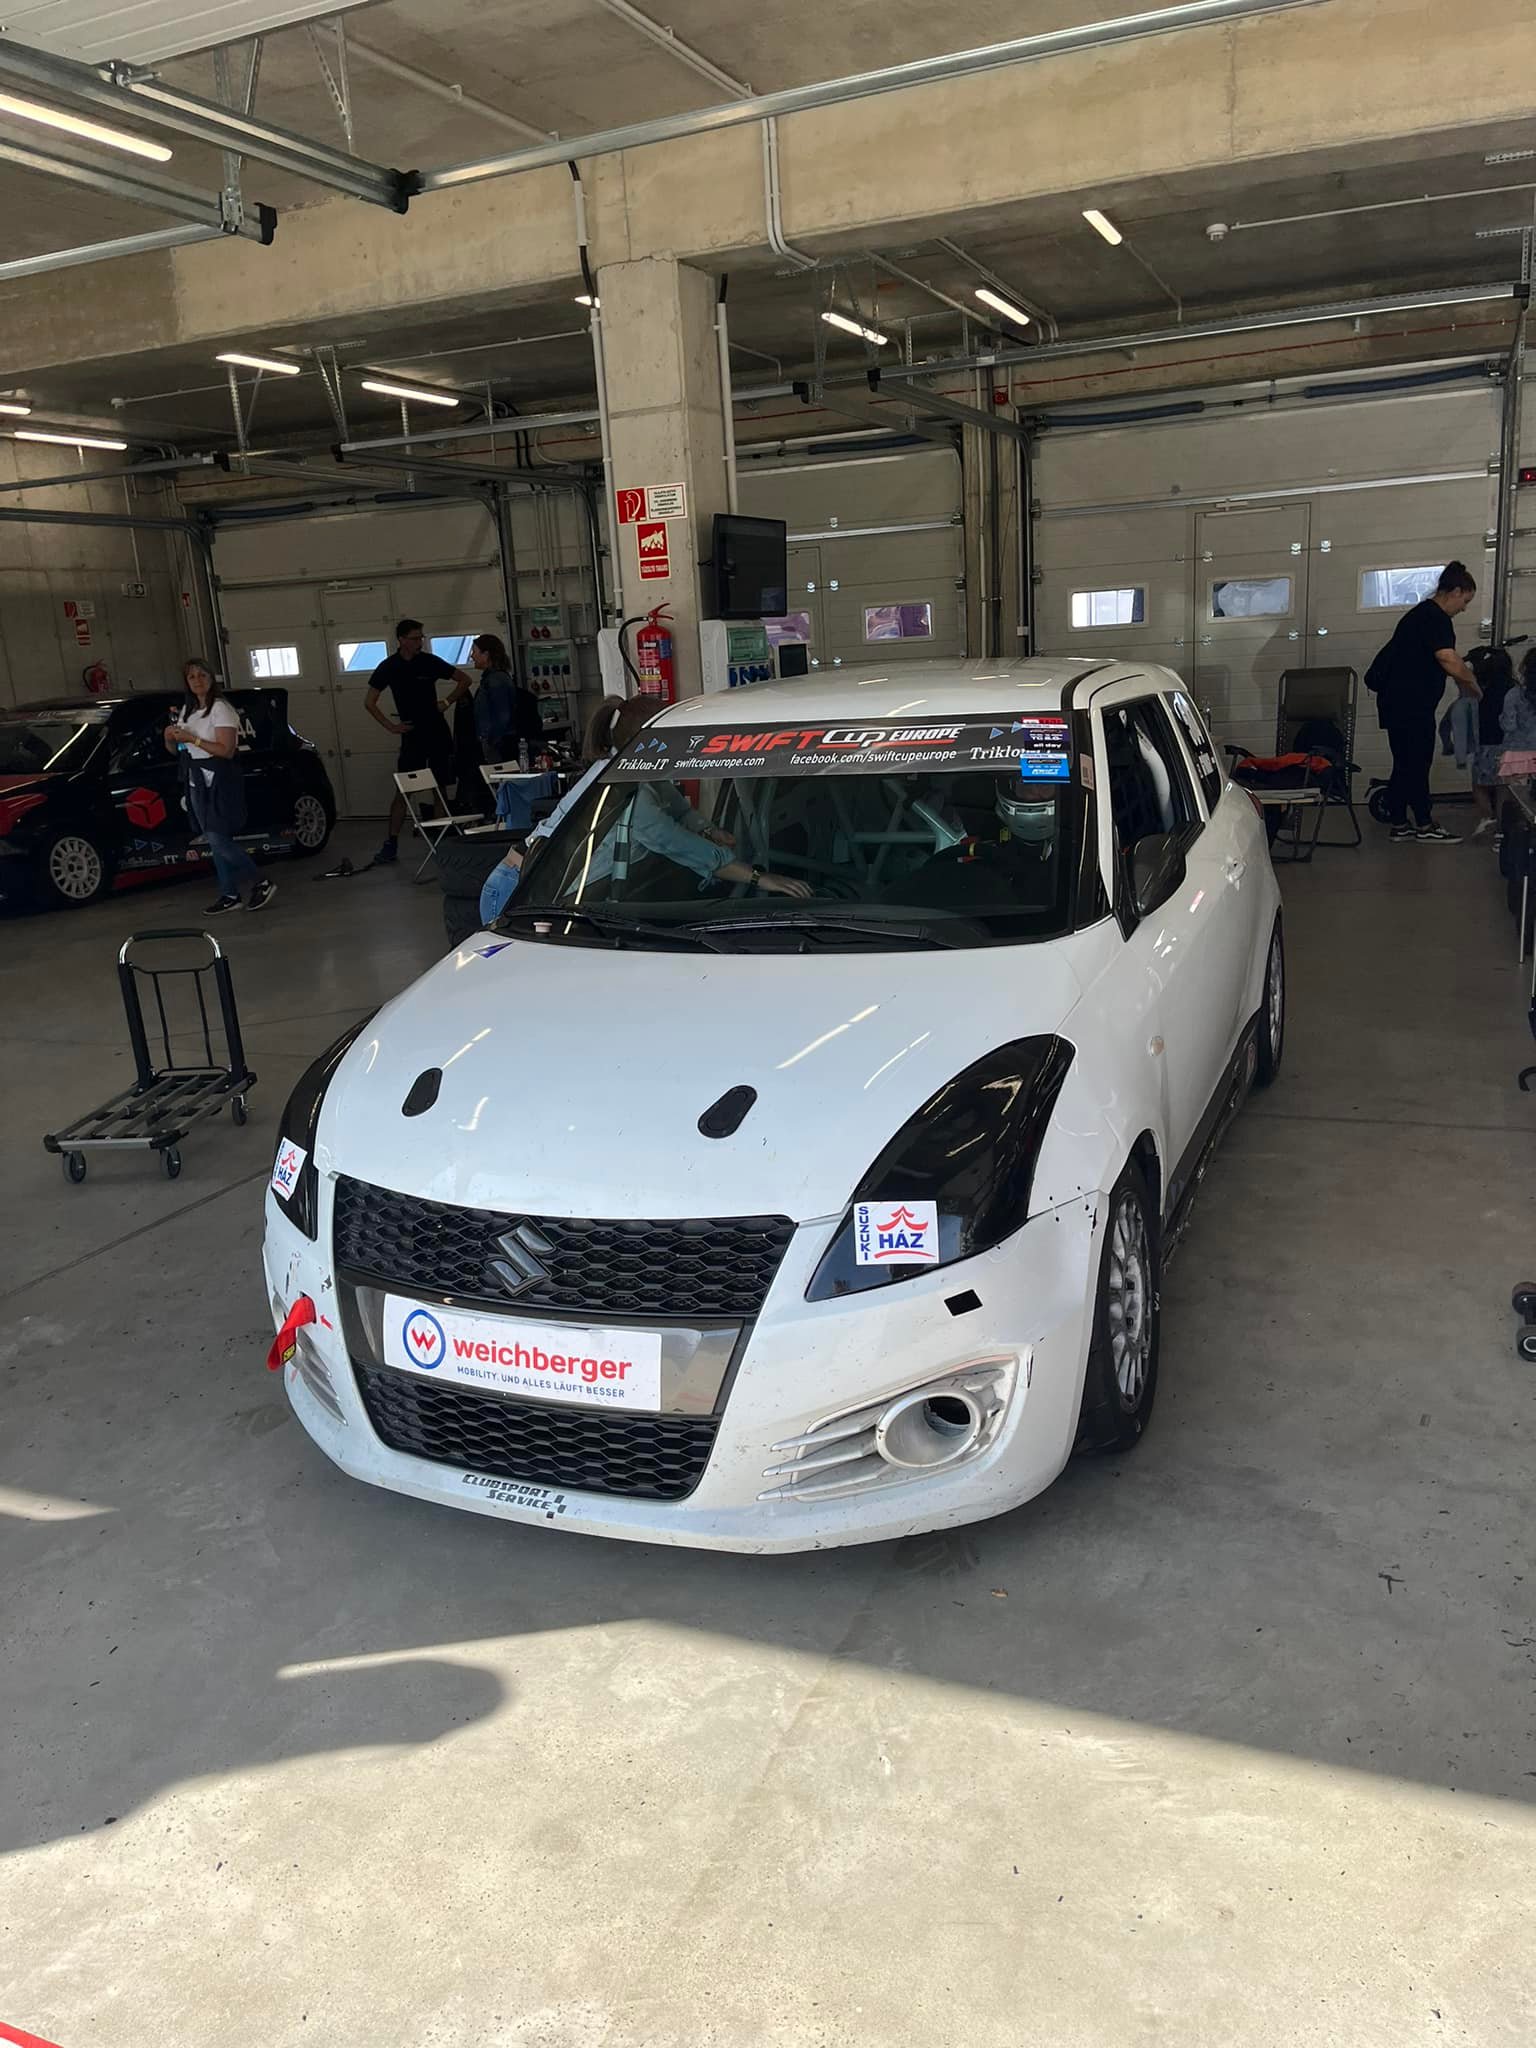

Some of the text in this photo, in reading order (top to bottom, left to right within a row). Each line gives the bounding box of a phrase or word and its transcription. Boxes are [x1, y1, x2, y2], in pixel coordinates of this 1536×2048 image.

[701, 731, 827, 753] SWIFT
[889, 727, 964, 741] EUROPE
[617, 758, 670, 770] Triklon-IT
[674, 757, 765, 770] swiftcupeurope.com
[790, 749, 956, 766] facebook.com/swiftcupeurope
[858, 1206, 871, 1260] SUZUKI
[879, 1229, 924, 1249] HÁZ
[453, 1338, 632, 1383] weichberger
[502, 1374, 520, 1384] UND
[522, 1378, 551, 1389] ALLES
[554, 1380, 583, 1393] LÄUFT
[586, 1386, 625, 1398] BESSER
[462, 1474, 552, 1498] CLUBSPORT
[486, 1490, 552, 1510] SERVICE
